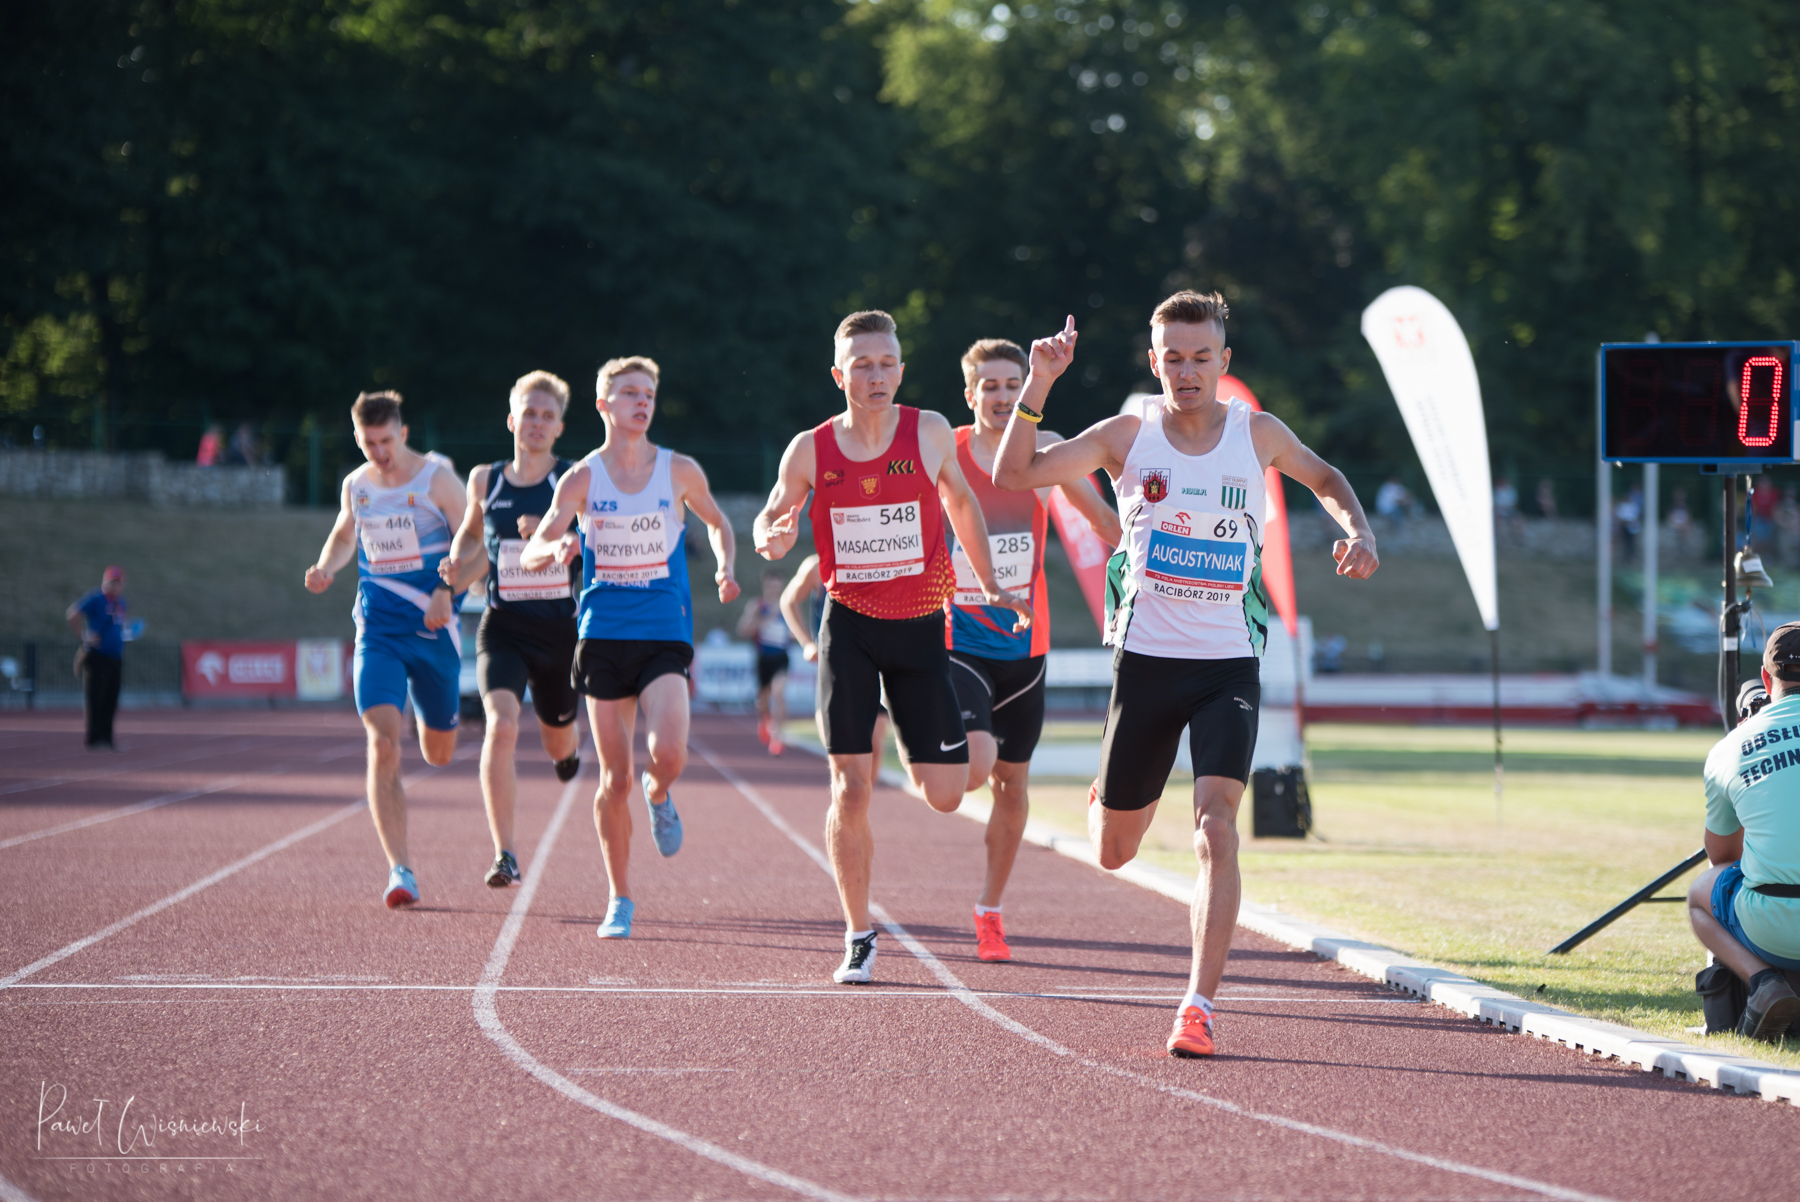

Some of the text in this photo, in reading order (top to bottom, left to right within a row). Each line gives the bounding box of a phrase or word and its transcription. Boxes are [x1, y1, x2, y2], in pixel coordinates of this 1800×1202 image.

[1737, 356, 1783, 447] 0
[592, 501, 618, 513] AZS
[879, 505, 916, 525] 548
[385, 516, 411, 531] 446
[631, 515, 661, 533] 606
[1162, 522, 1190, 535] ORLEN
[1213, 518, 1238, 539] 69
[596, 540, 665, 557] PRZYBYLAK
[837, 534, 919, 554] MASACZYŃSKI
[996, 536, 1030, 554] 285
[1151, 543, 1243, 572] AUGUSTYNIAK
[641, 570, 658, 578] 2019
[846, 566, 913, 580] RACIBÓRZ 2019
[1154, 582, 1230, 602] RACIBÓRZ 2019
